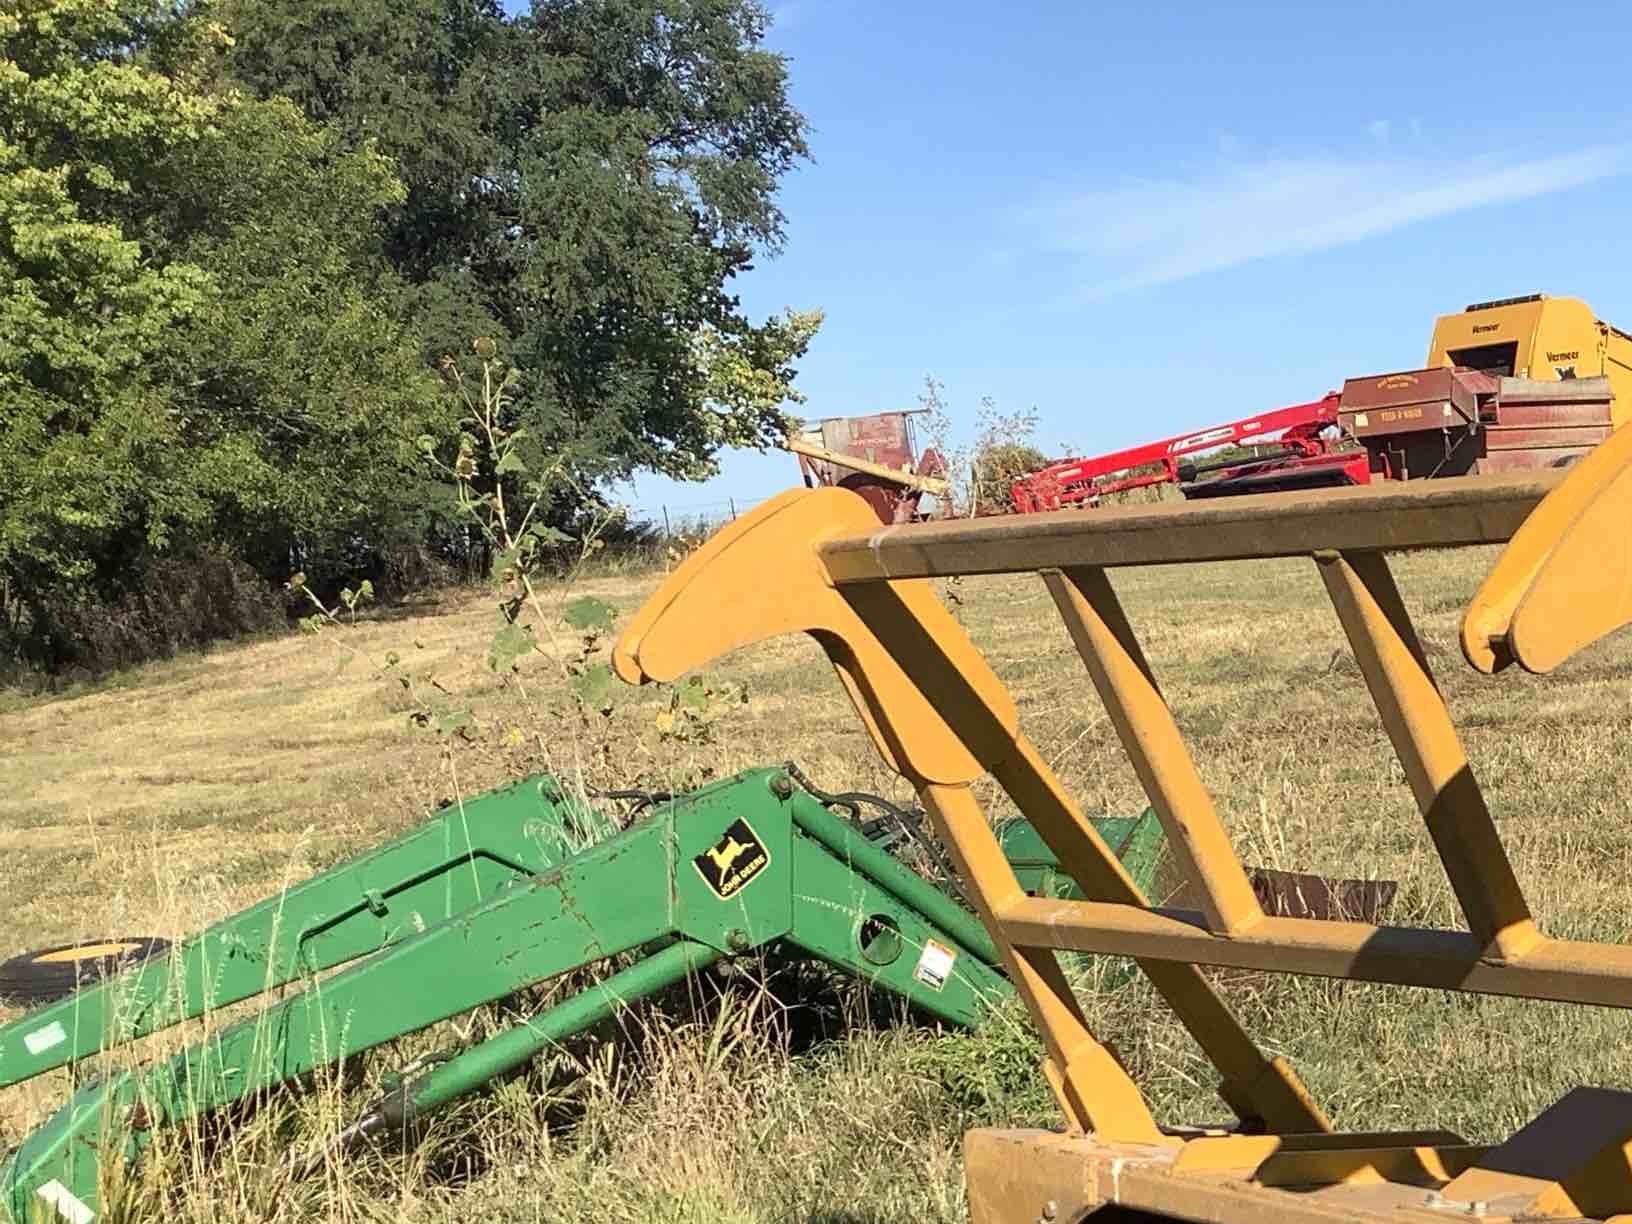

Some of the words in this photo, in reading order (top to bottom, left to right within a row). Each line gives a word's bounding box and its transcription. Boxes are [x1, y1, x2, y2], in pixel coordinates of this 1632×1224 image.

[1545, 351, 1579, 363] Vermeer
[721, 874, 742, 895] JOHN
[740, 854, 766, 878] DEERE
